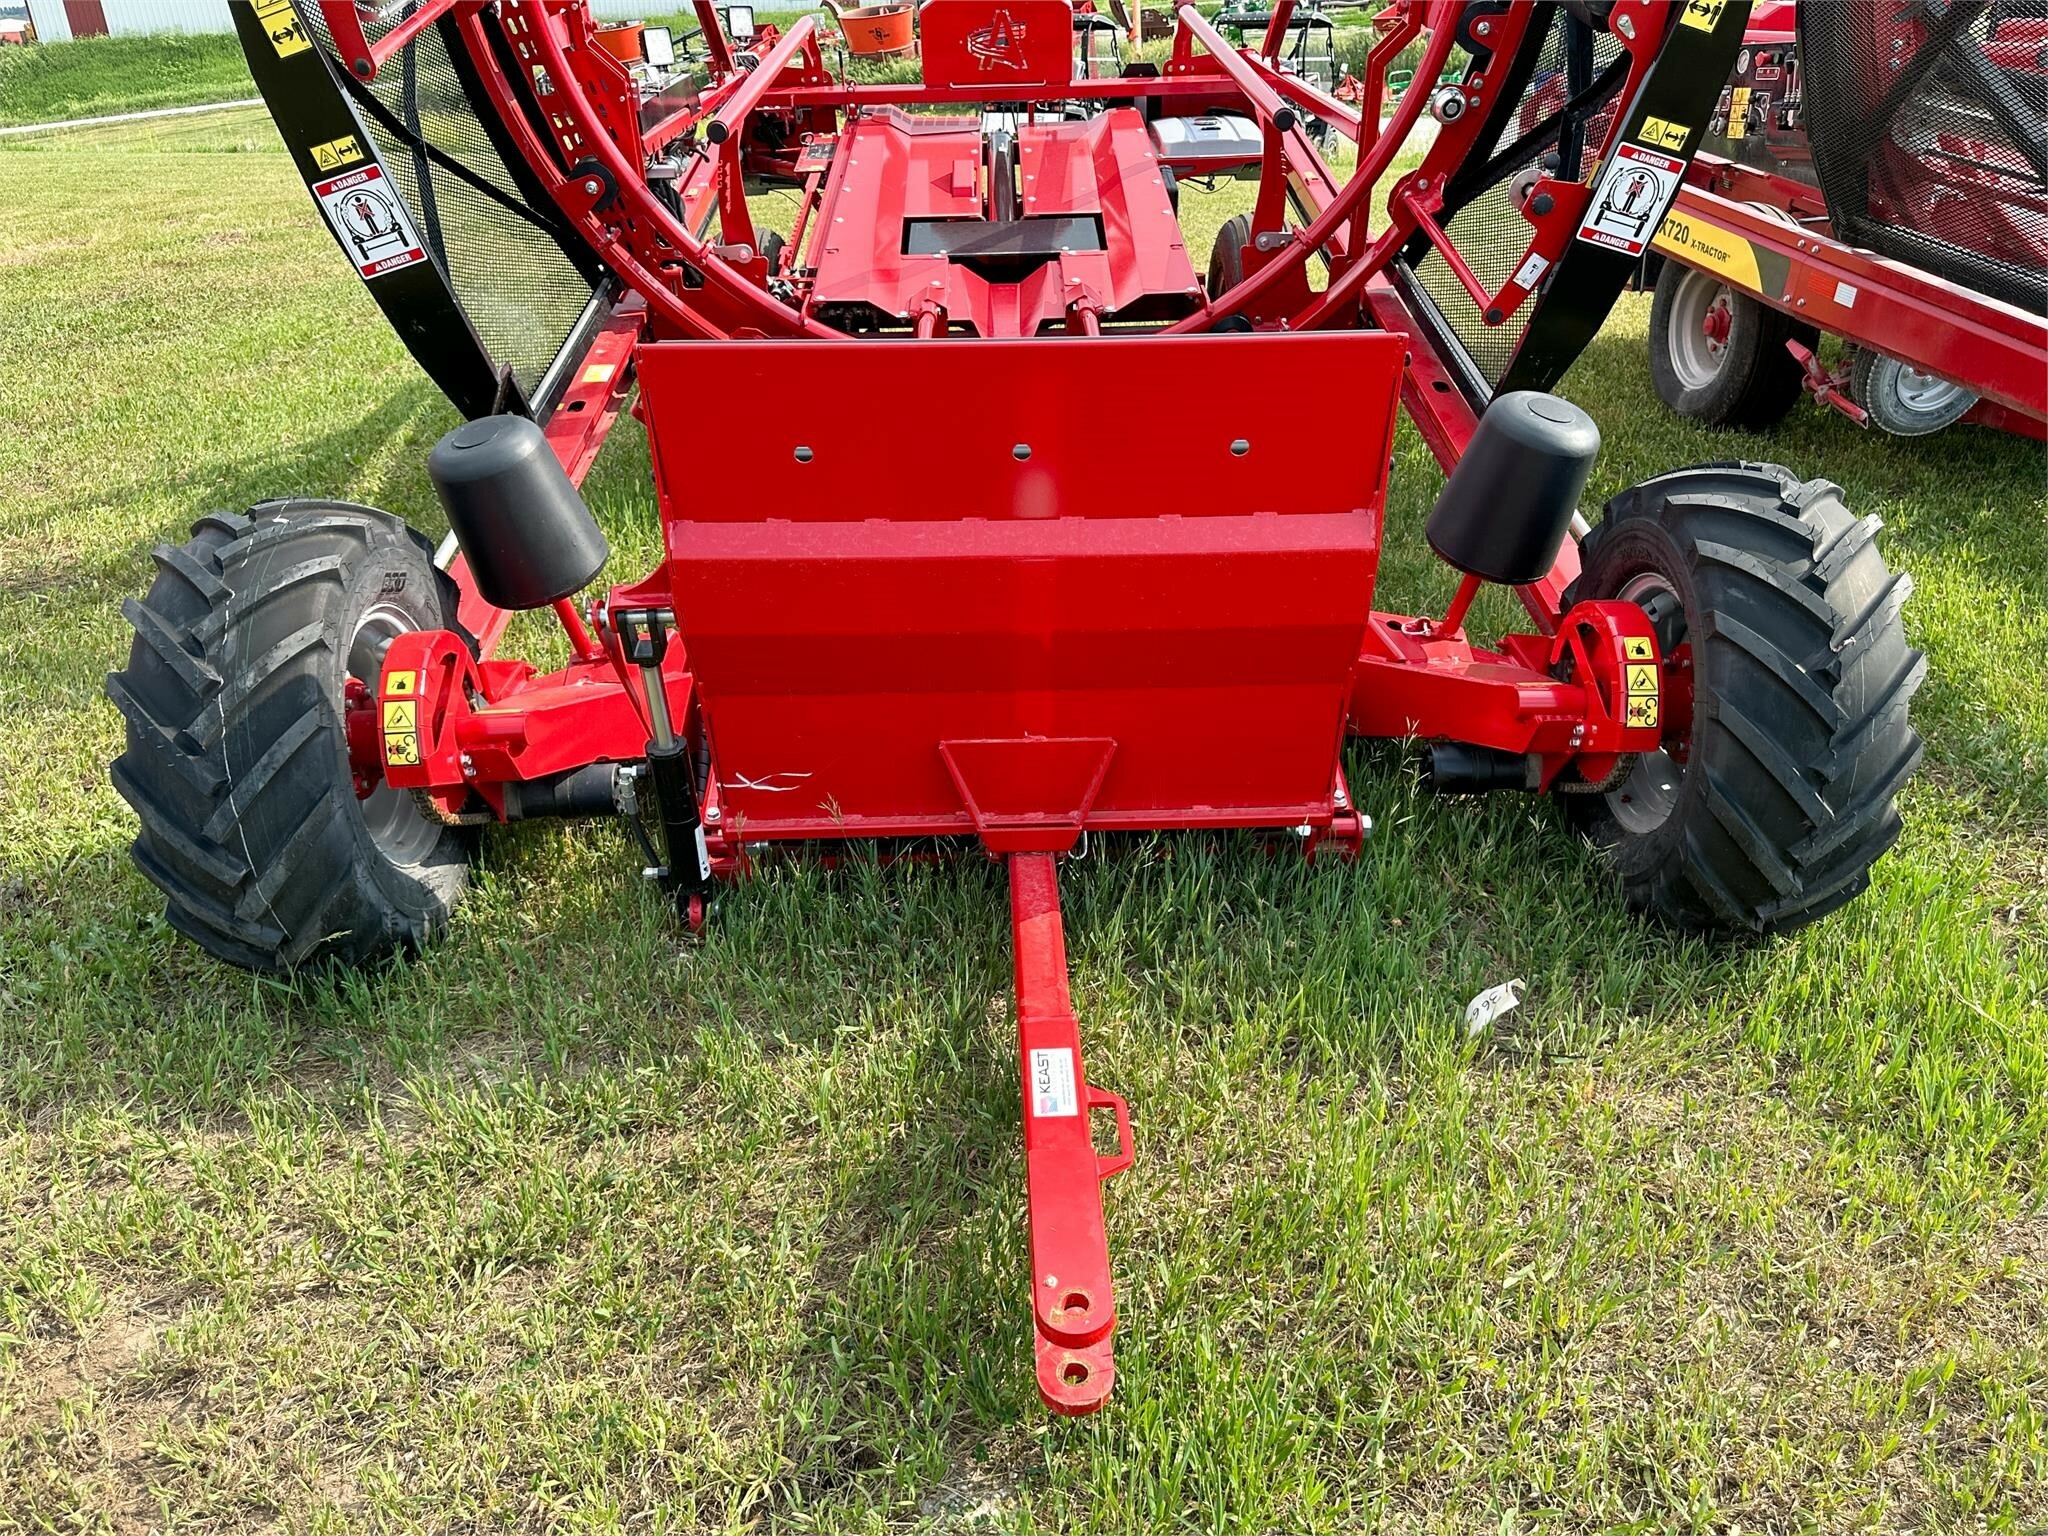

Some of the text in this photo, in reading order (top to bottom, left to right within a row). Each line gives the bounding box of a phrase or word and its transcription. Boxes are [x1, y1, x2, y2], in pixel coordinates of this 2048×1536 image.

[1639, 151, 1671, 169] DANGER
[337, 172, 369, 188] DANGER
[1600, 236, 1631, 250] DANGER
[382, 253, 413, 269] DANGER
[1037, 1051, 1051, 1094] KEAST
